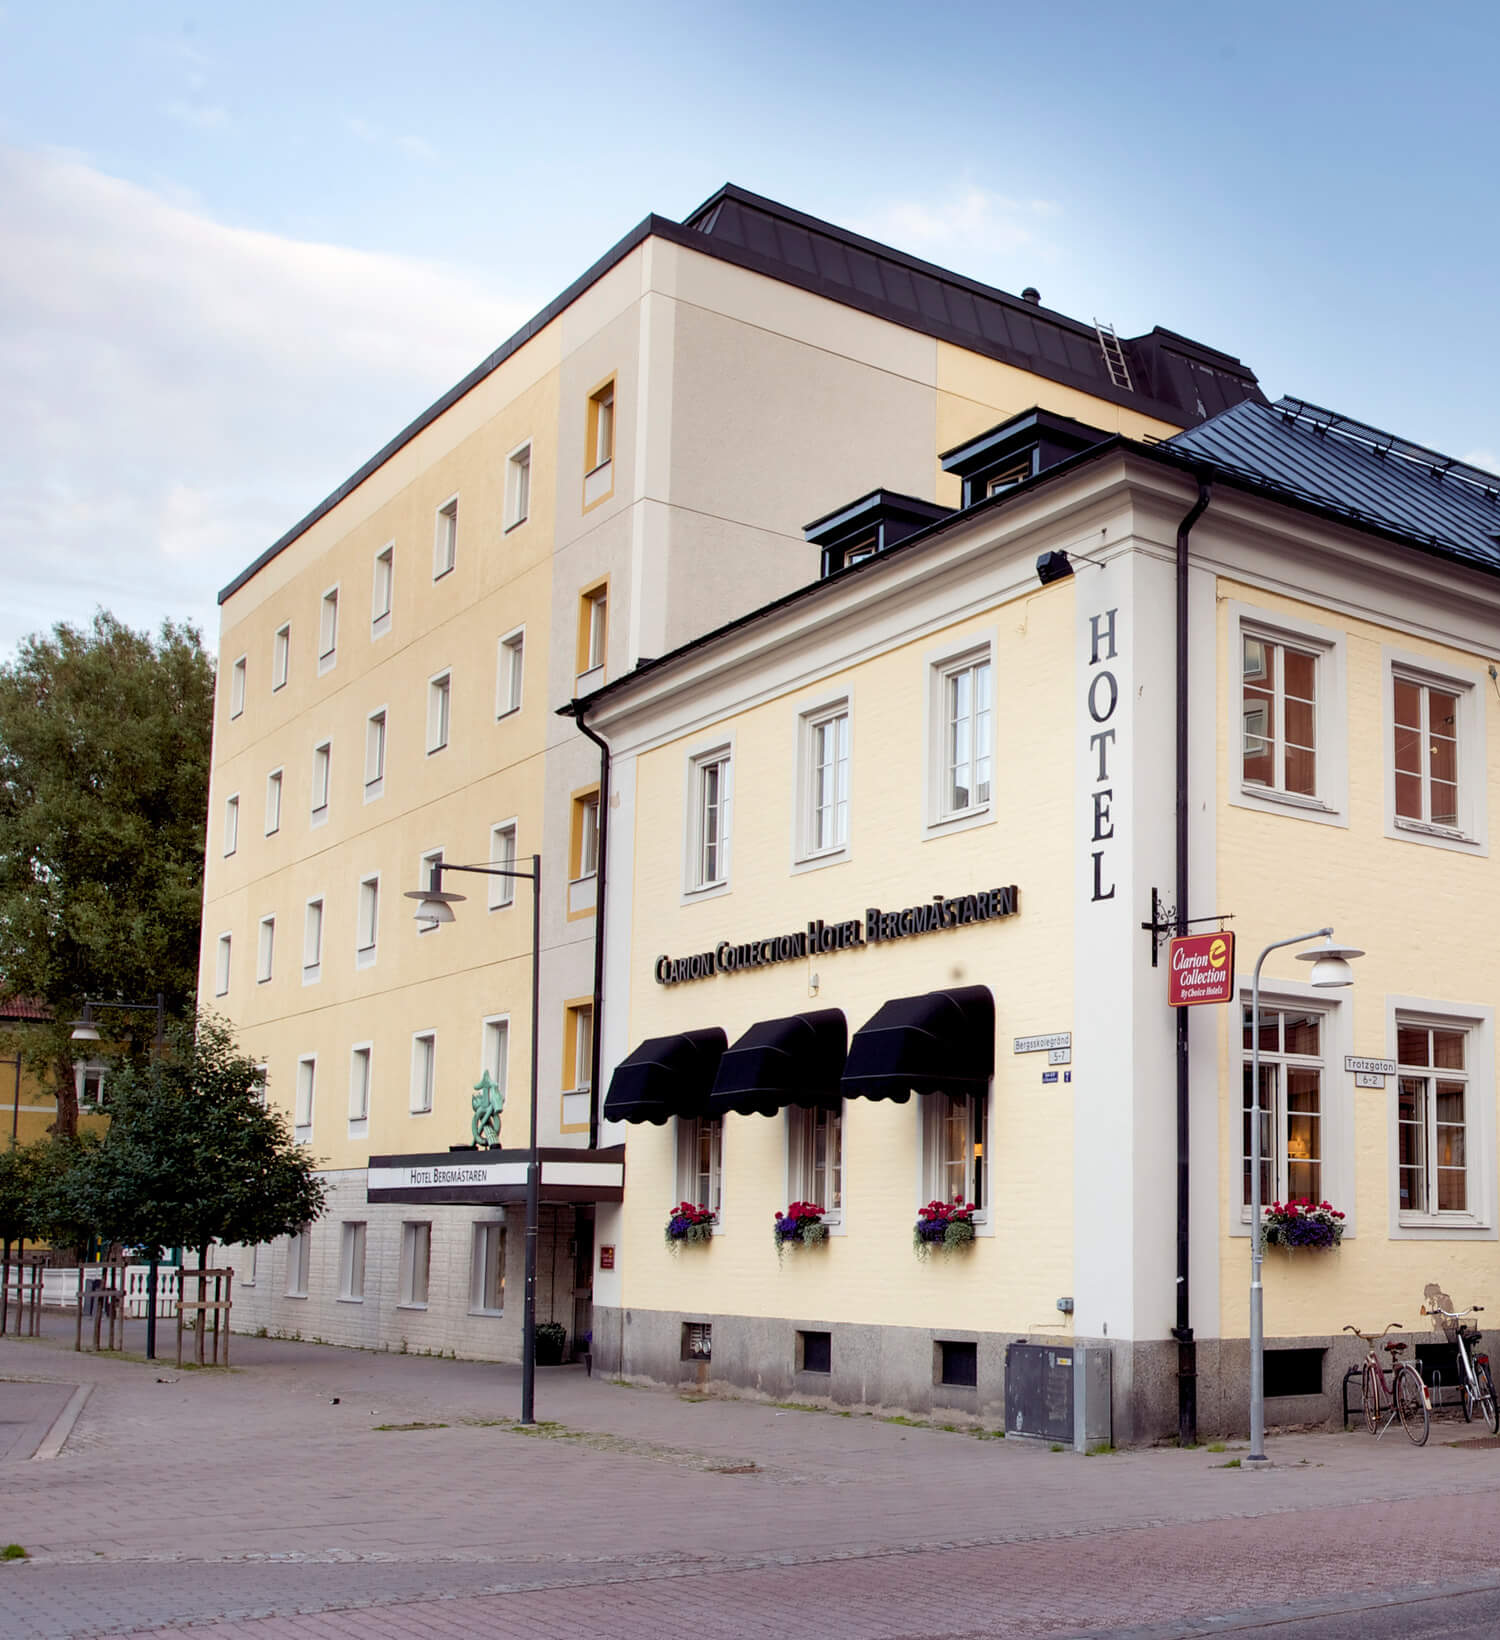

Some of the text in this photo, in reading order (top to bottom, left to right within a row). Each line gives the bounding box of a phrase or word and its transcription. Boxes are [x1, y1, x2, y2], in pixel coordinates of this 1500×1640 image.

[1088, 608, 1119, 902] HOTEL
[655, 952, 716, 985] CLARION
[715, 932, 807, 973] COLLECTION
[807, 919, 864, 955] HOTEL
[1173, 947, 1208, 971] Clarion
[1180, 968, 1226, 986] Collection
[1188, 987, 1206, 998] Choice
[1206, 985, 1223, 995] Hotels
[1347, 1058, 1394, 1072] Trotzgatan
[1362, 1075, 1378, 1085] 6-2
[410, 1169, 432, 1184] HOTEL
